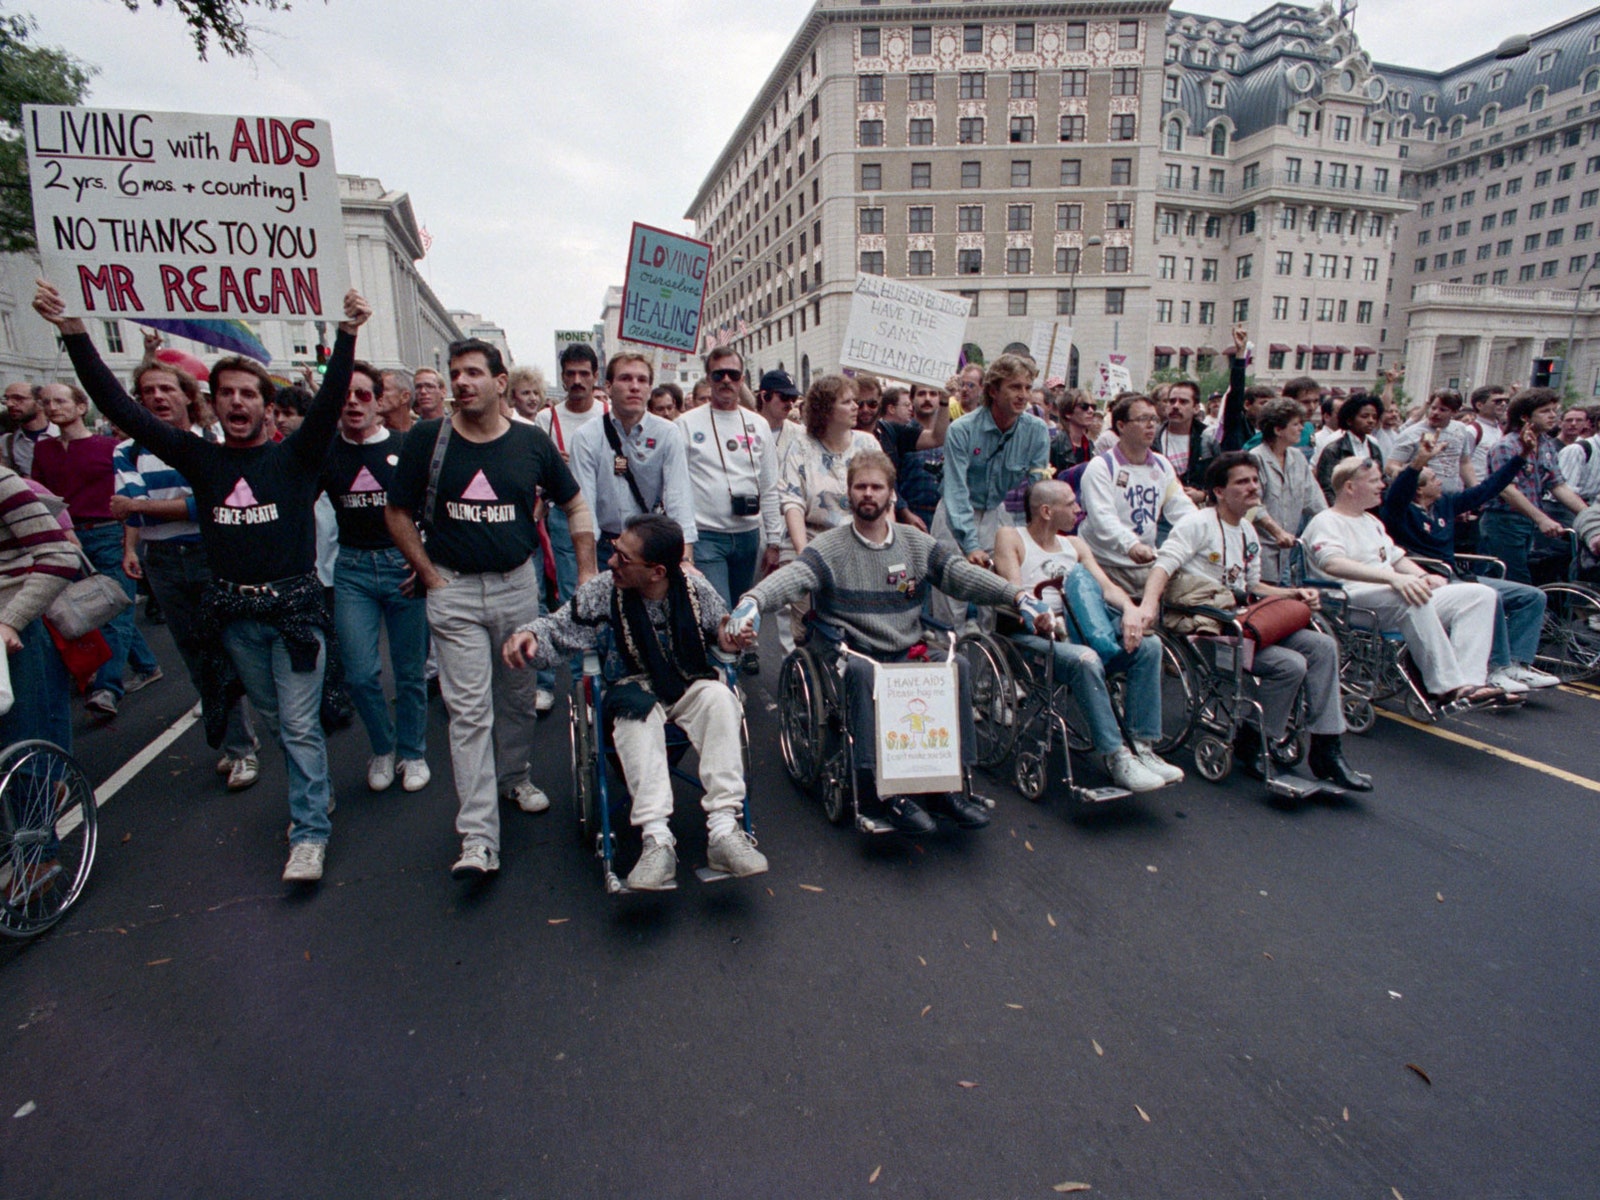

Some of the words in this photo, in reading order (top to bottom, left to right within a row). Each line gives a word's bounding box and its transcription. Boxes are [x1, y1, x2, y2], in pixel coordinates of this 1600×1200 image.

[32, 110, 154, 158] LIVING
[168, 131, 219, 159] with
[229, 117, 320, 167] AIDS
[44, 160, 69, 190] 2
[73, 176, 107, 202] yrs.
[118, 163, 139, 197] 6
[143, 177, 176, 192] mos.
[53, 216, 96, 251] NO
[99, 218, 217, 255] THANKS
[218, 221, 258, 255] TO
[262, 223, 318, 259] YOU
[639, 235, 706, 280] LOVING
[77, 264, 145, 312] MR
[159, 265, 323, 315] REAGAN
[640, 271, 702, 297] ourselves
[625, 290, 698, 337] HEALING
[871, 301, 906, 321] HAVE
[911, 309, 937, 330] THE
[557, 331, 594, 341] MONEY
[628, 324, 690, 348] ourselves
[876, 321, 921, 344] SAME
[446, 501, 516, 523] SILENCE=DEATH
[894, 677, 920, 688] HAVE
